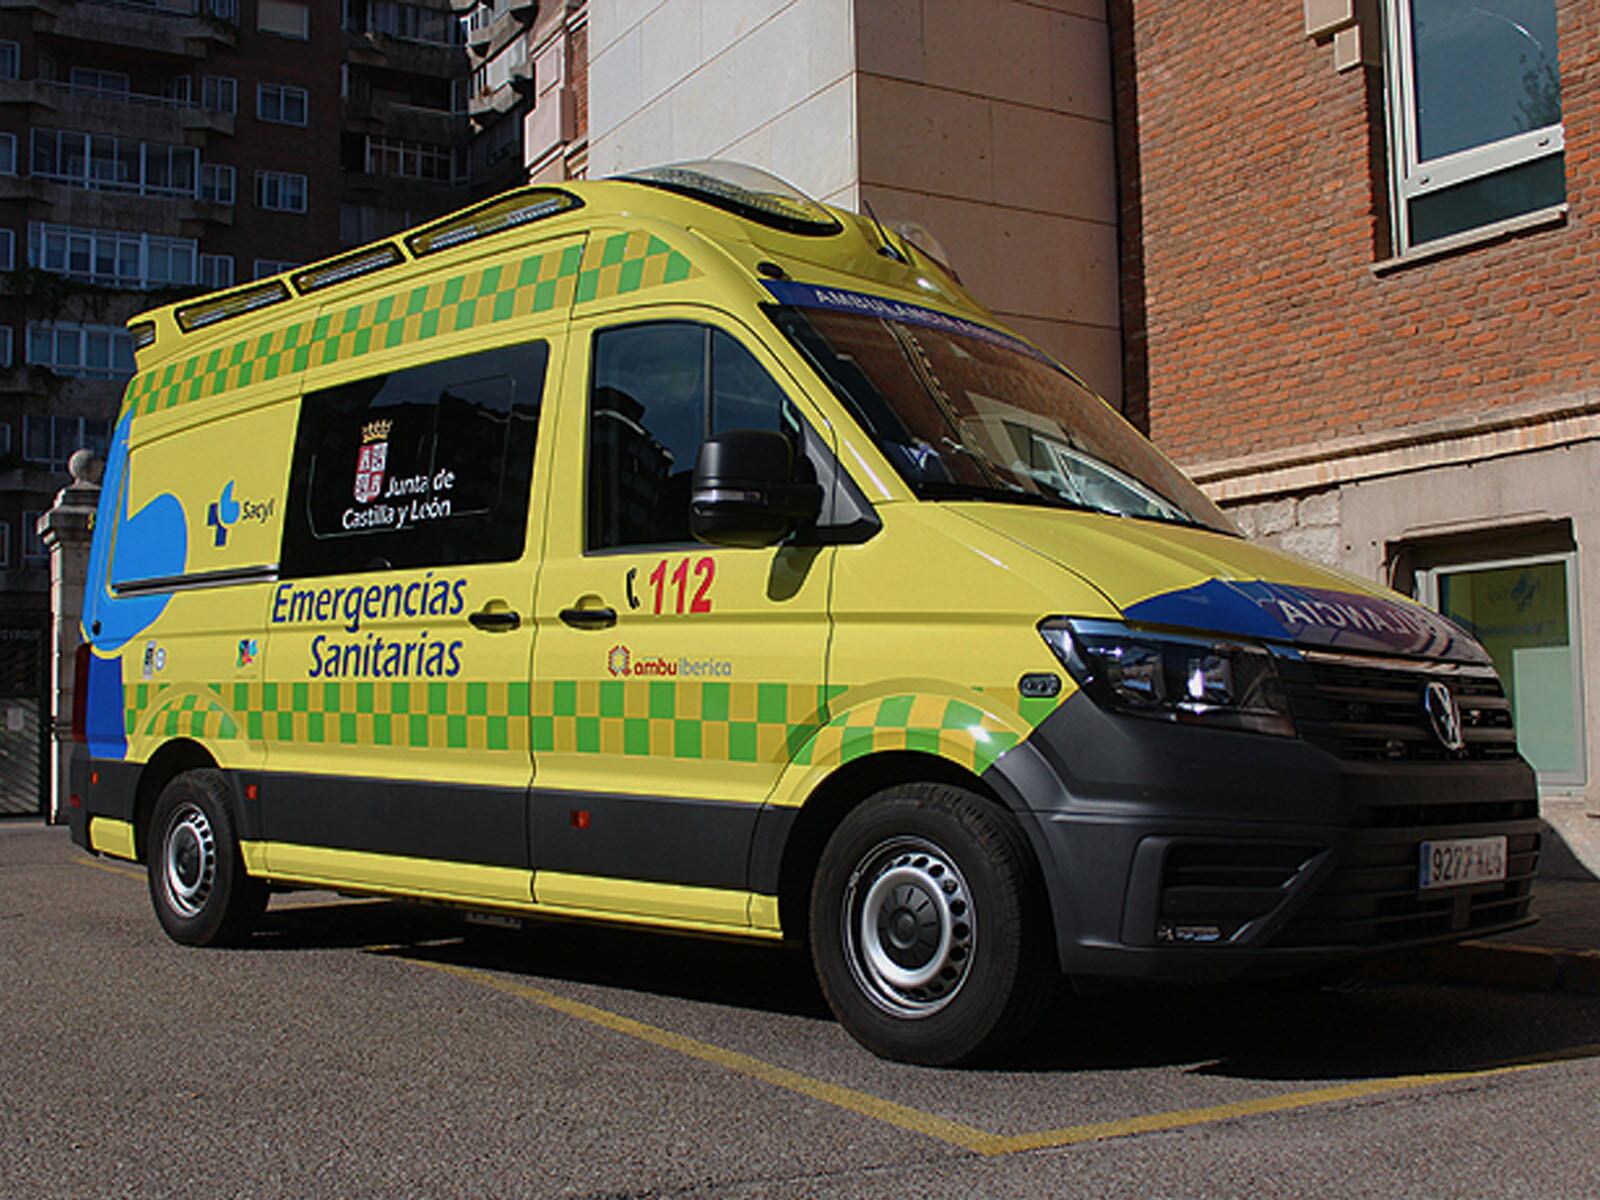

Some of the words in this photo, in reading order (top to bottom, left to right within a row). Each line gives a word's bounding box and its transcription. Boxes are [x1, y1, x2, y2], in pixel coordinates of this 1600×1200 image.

[384, 474, 430, 498] Junta
[433, 468, 456, 491] de
[242, 498, 274, 524] Sacyl
[342, 503, 395, 529] Castilla
[395, 504, 409, 530] y
[410, 496, 451, 521] León
[272, 571, 467, 633] Emergencias
[648, 556, 716, 615] 112
[309, 631, 463, 678] Sanitarias
[634, 657, 732, 676] ambuiberica
[1432, 845, 1473, 881] 9277
